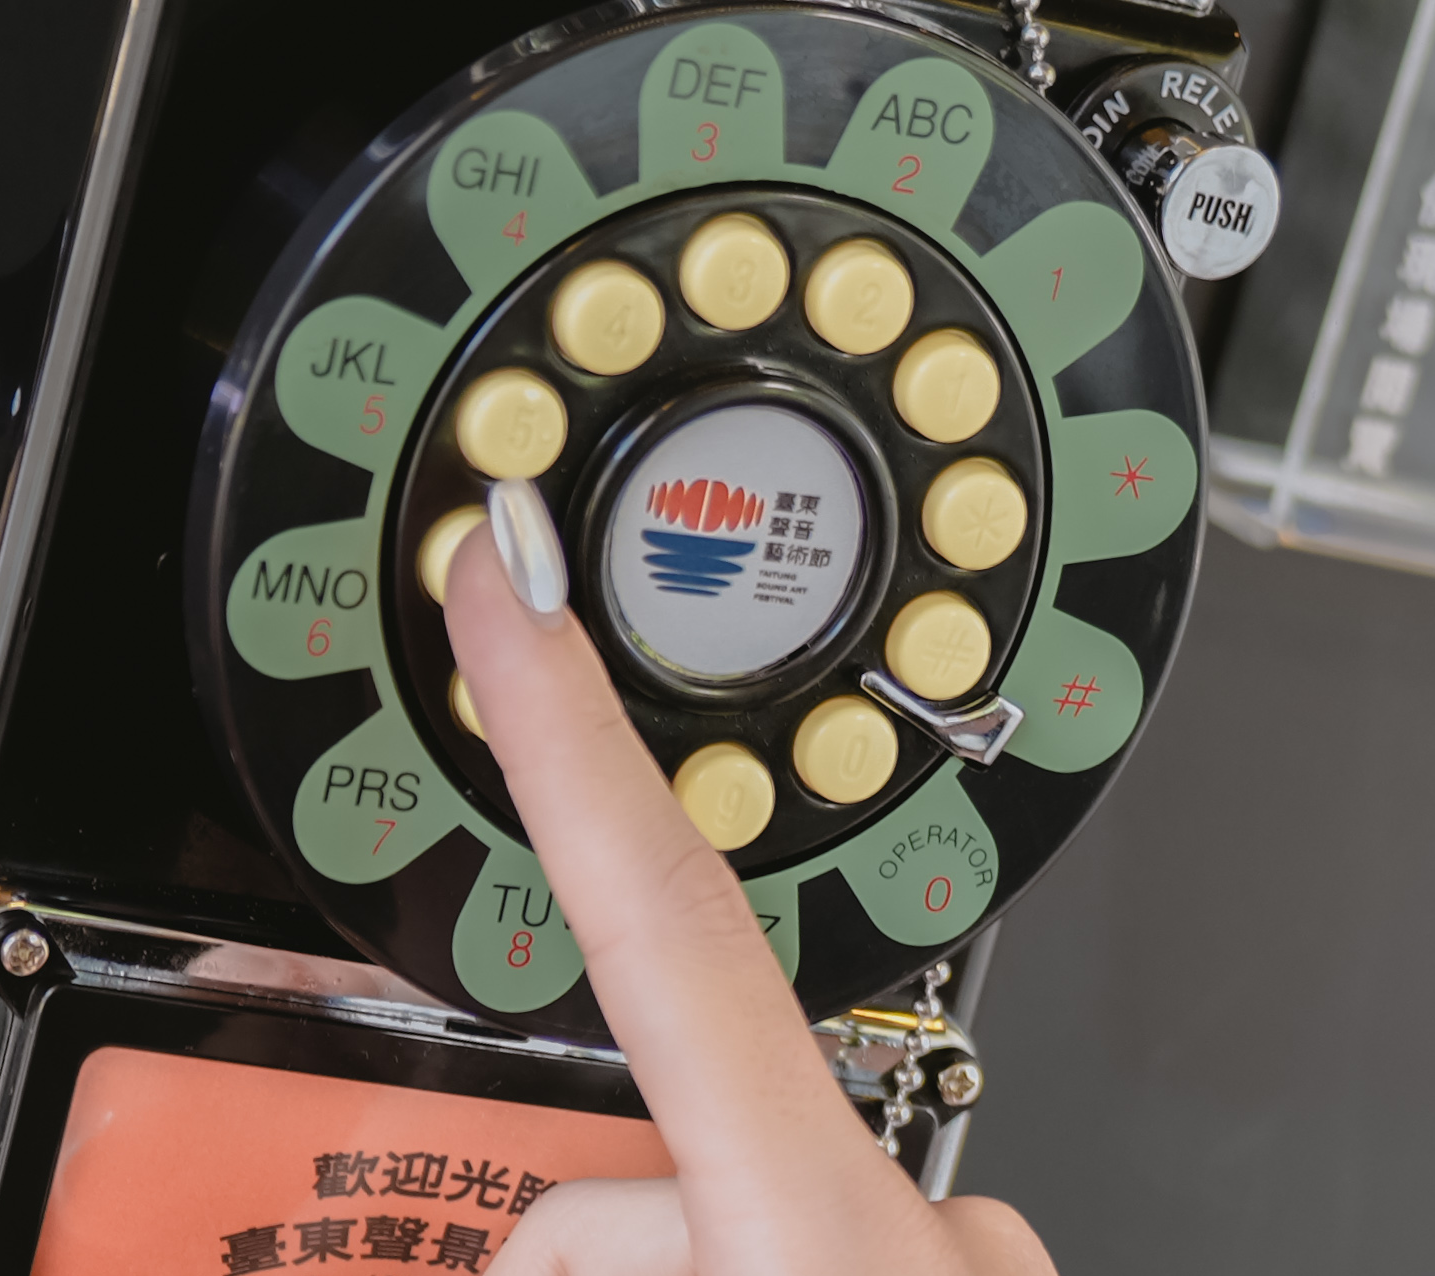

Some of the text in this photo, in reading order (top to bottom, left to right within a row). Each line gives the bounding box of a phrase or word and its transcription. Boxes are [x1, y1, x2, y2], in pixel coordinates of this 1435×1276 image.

[668, 57, 765, 110] DEF
[871, 93, 974, 146] ABC
[1081, 70, 1245, 150] OIN RELE
[689, 124, 721, 162] 3
[450, 147, 541, 198] GHI
[891, 156, 921, 195] 2
[501, 211, 529, 247] 4
[1187, 192, 1253, 235] PUSH
[1049, 267, 1064, 302] 1
[310, 338, 397, 387] JKL
[359, 396, 387, 436] 5
[773, 491, 821, 516] 臺東
[768, 516, 814, 541] 聲音
[763, 542, 832, 568] 藝術節
[251, 559, 369, 612] MNO
[755, 582, 808, 595] SOUND ART
[758, 569, 797, 581] TAITUNG
[305, 618, 333, 657] 6
[322, 763, 421, 814] PRS
[370, 820, 397, 856] 7
[878, 824, 995, 889] OPERATOR
[492, 884, 570, 930] TU
[924, 876, 952, 912] 0
[506, 929, 535, 968] 8
